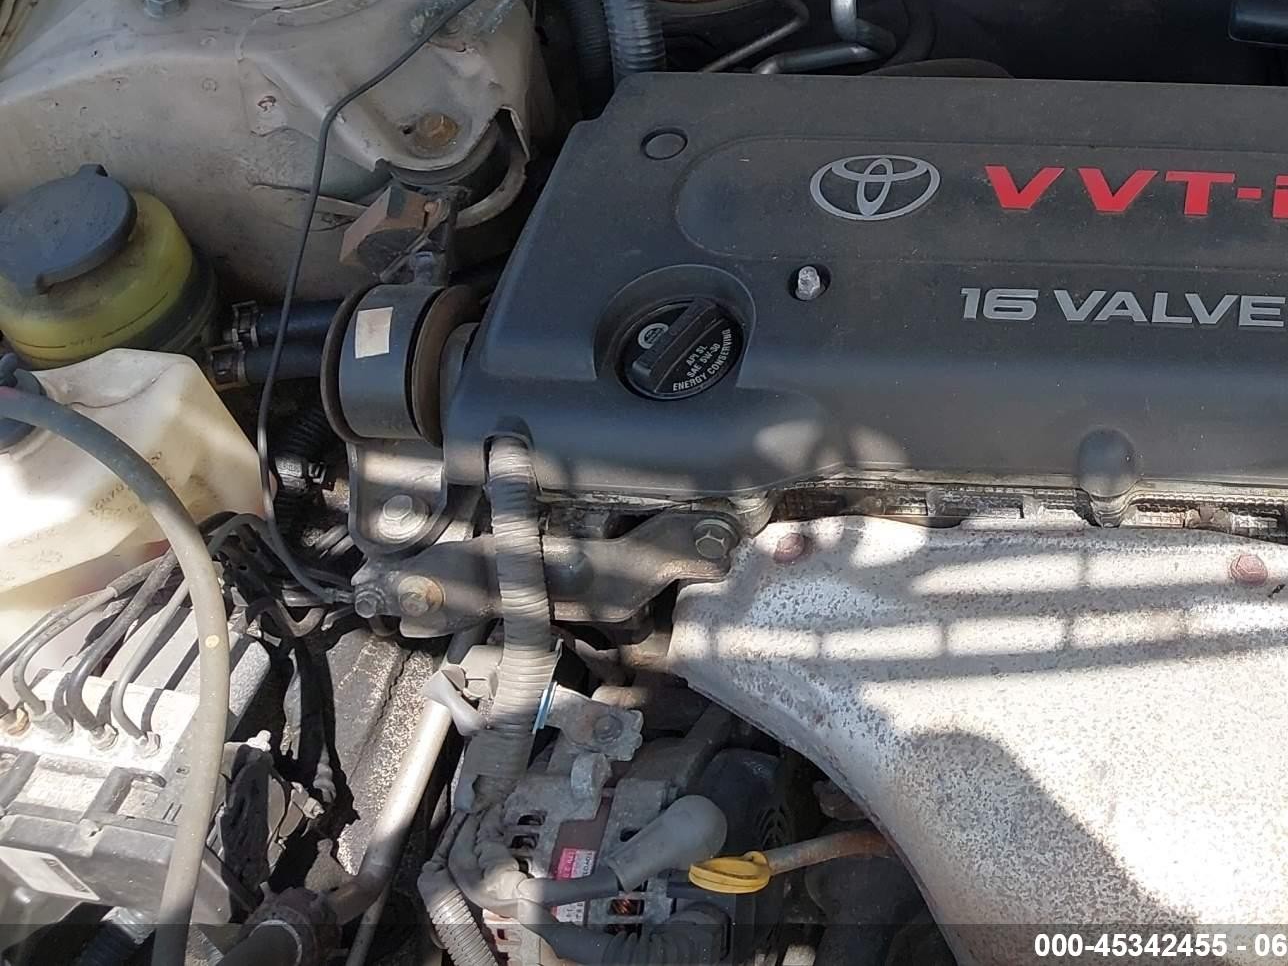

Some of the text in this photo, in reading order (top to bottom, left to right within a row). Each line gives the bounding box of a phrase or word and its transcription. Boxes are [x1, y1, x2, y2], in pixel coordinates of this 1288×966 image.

[960, 287, 1287, 328] 16 VALVE
[672, 328, 733, 392] ENERGY CONSERVING
[686, 345, 708, 366] API SL
[686, 343, 721, 378] SAE 5W-30
